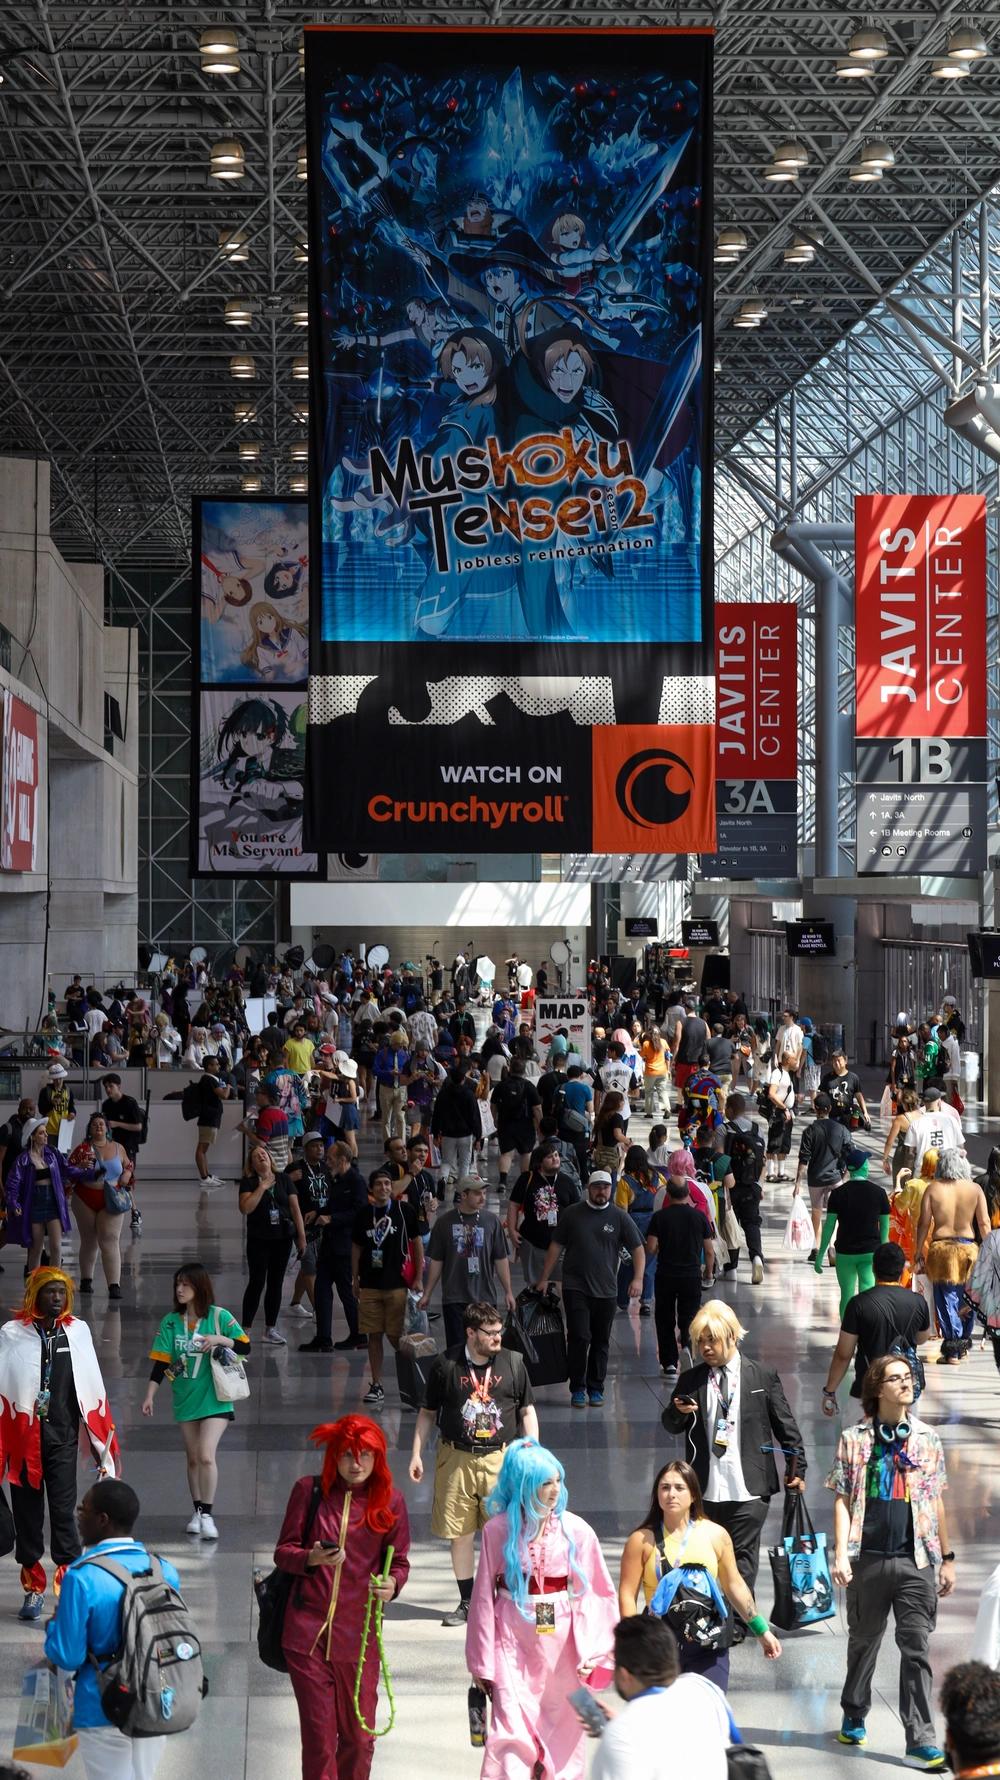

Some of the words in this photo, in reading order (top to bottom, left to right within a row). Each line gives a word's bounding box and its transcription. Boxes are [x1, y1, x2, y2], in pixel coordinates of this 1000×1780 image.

[370, 428, 634, 509] Mushoku
[605, 486, 620, 531] season
[615, 478, 655, 530] 2
[457, 552, 521, 573] jobless
[528, 538, 654, 562] reincarnation
[880, 526, 917, 704] JAVITS
[935, 526, 964, 706] CENTER
[719, 625, 746, 755] JAVITS
[760, 624, 780, 756] CENTER
[440, 765, 521, 783] WATCH
[527, 765, 562, 783] ON
[892, 738, 952, 783] 1B
[367, 794, 565, 829] Crunchyroll
[724, 780, 776, 814] 3A
[880, 793, 902, 802] Javits
[904, 793, 925, 802] North
[880, 829, 891, 837] 1B
[892, 828, 923, 838] Meeting
[924, 829, 951, 837] Rooms
[894, 811, 906, 820] 3A
[231, 831, 258, 843] You
[260, 833, 287, 843] are
[539, 1003, 586, 1019] MAP
